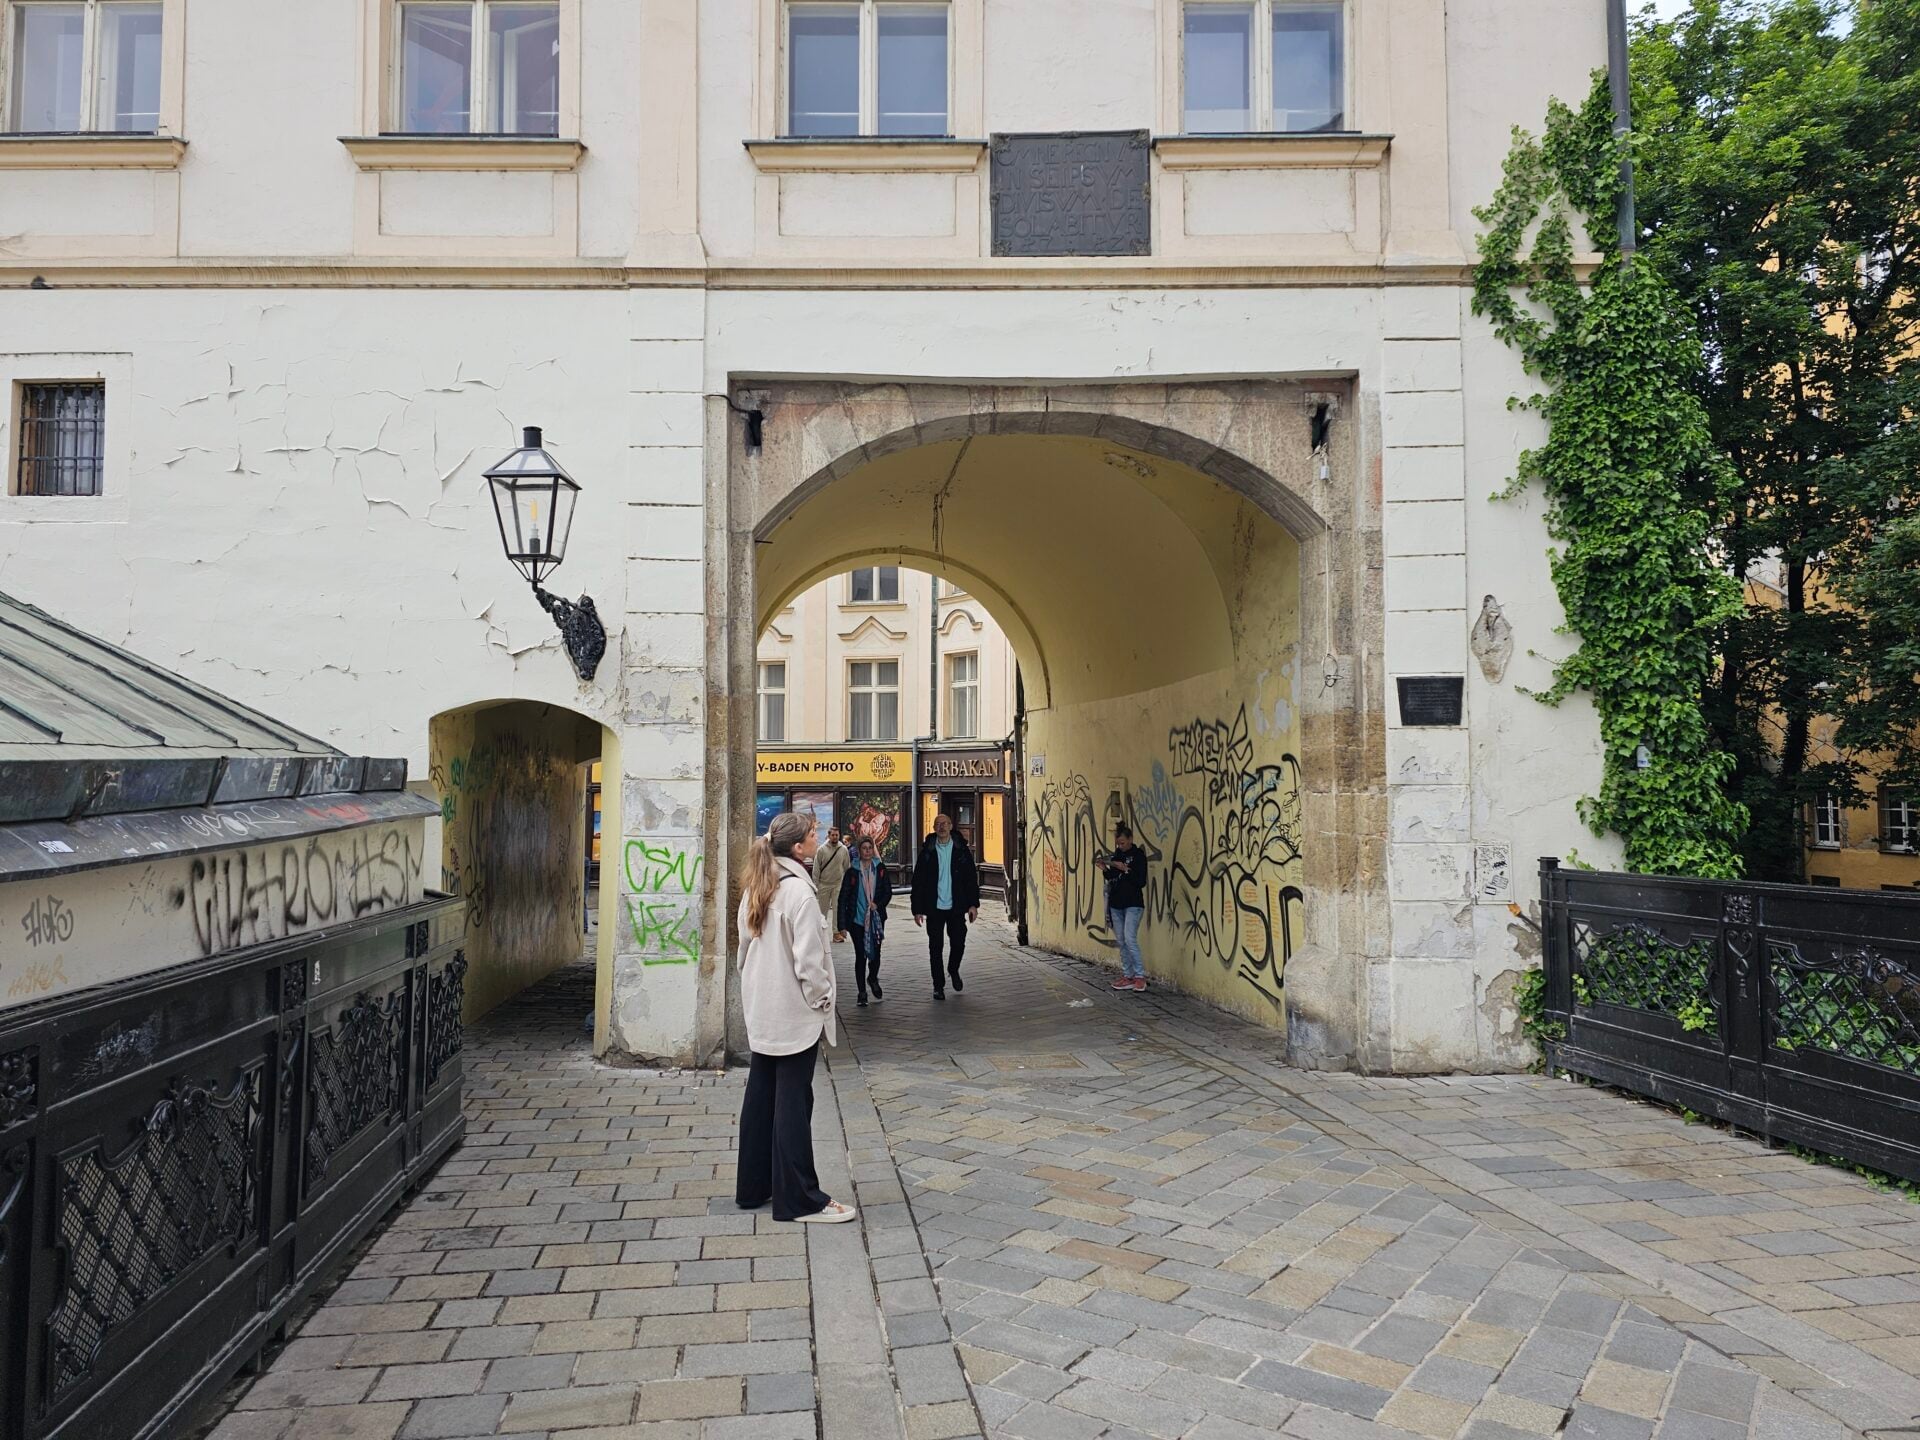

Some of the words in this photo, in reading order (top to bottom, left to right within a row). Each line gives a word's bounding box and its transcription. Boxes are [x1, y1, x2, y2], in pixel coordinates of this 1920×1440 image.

[756, 762, 810, 772] Y-BADEN
[813, 762, 855, 772] PHOTO
[923, 758, 1000, 778] BARBAKAN
